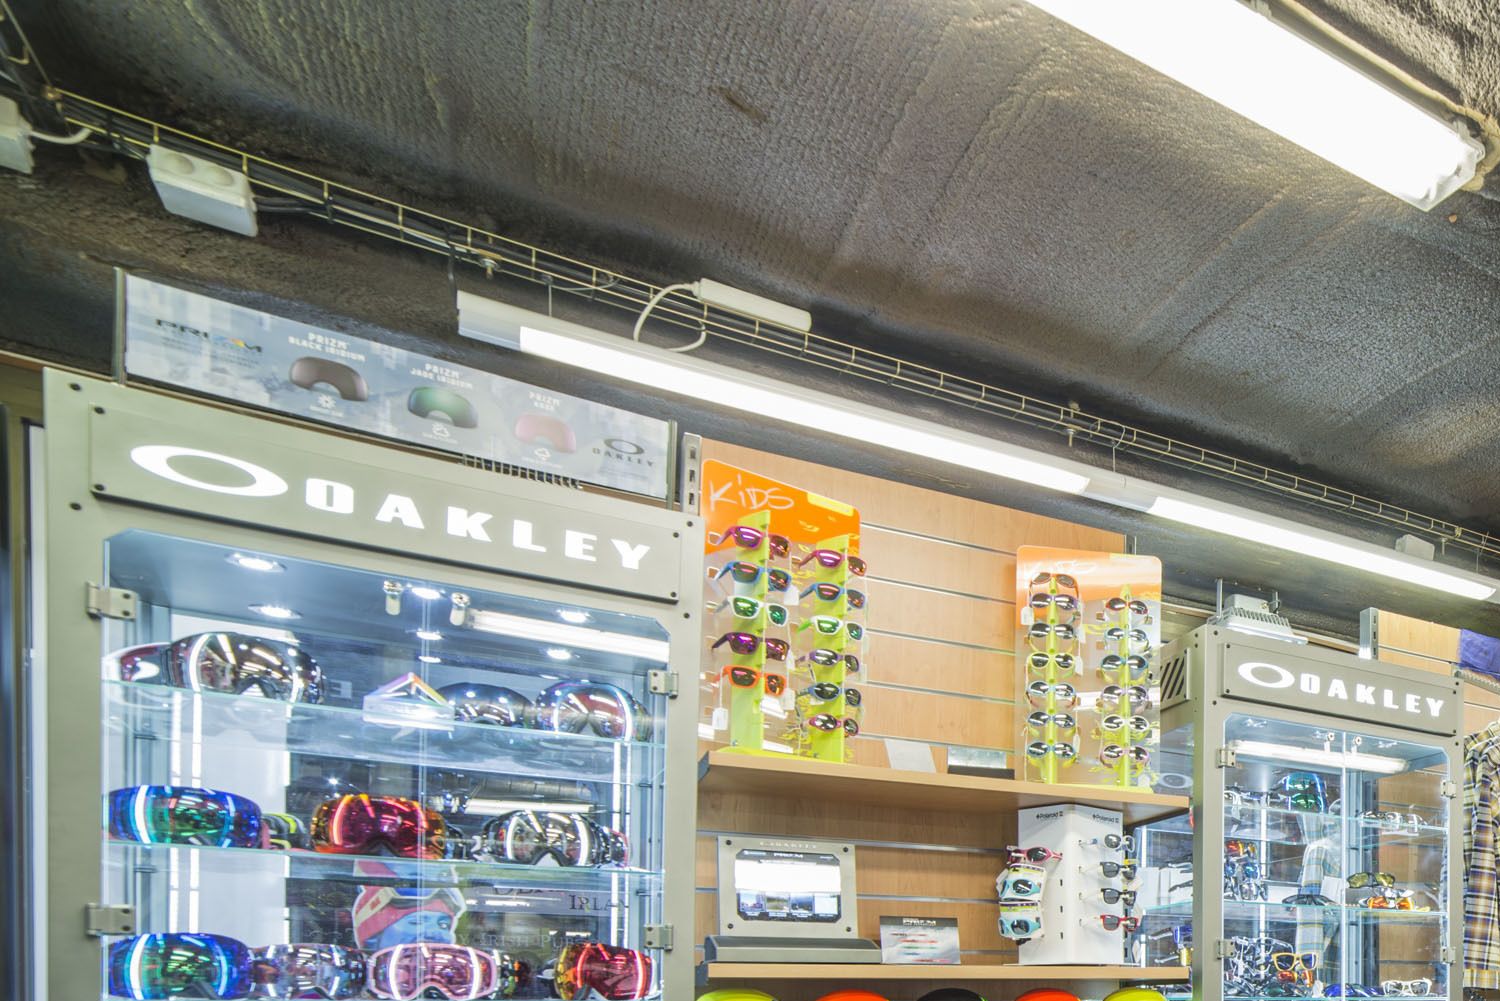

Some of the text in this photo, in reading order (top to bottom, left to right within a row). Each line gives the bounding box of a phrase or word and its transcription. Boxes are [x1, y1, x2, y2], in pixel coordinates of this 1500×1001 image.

[591, 446, 655, 467] OAKLEY
[305, 477, 651, 570] OAKLEY
[1300, 673, 1445, 718] OAKLEY
